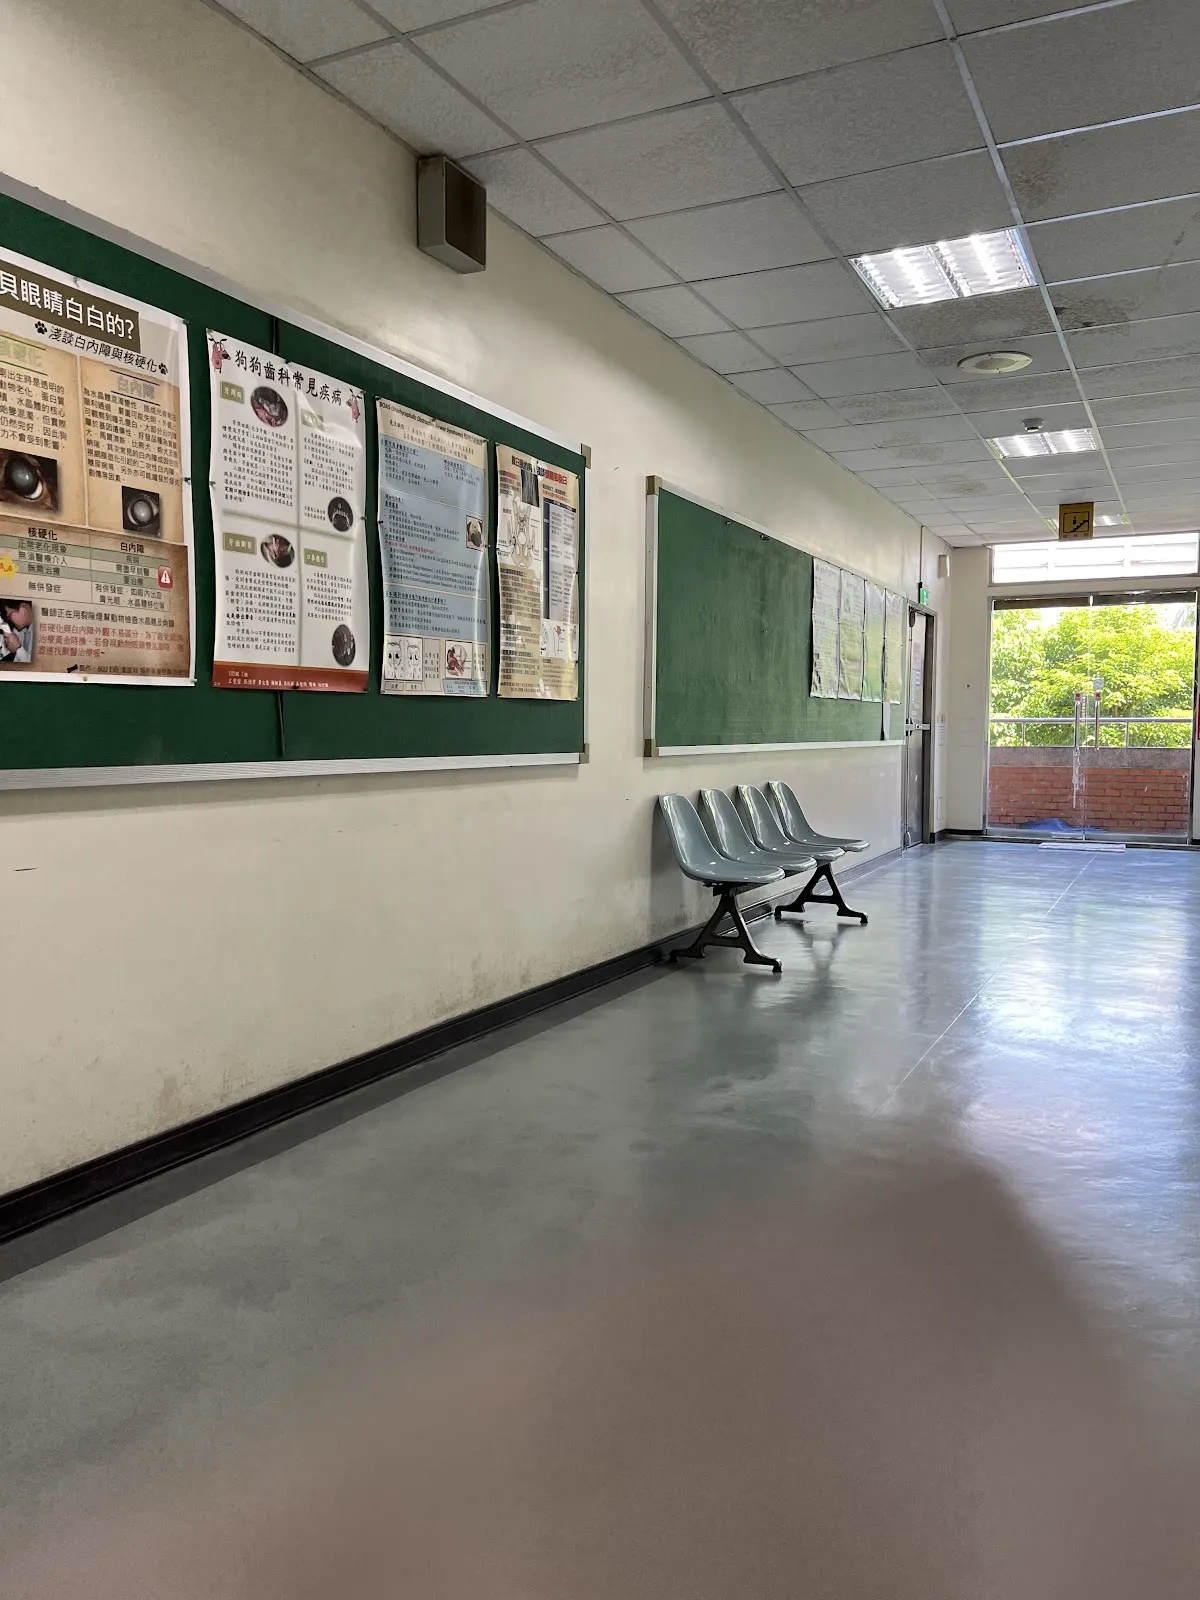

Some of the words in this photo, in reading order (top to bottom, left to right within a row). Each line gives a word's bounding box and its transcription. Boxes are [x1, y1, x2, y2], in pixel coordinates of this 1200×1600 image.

[0, 272, 135, 340] 貝眼睛白白的?
[48, 325, 158, 374] 淺談白內障與核硬化
[234, 350, 342, 406] 狗狗齒科常見疾病
[28, 527, 58, 541] 核硬化
[120, 541, 144, 554] 白內障
